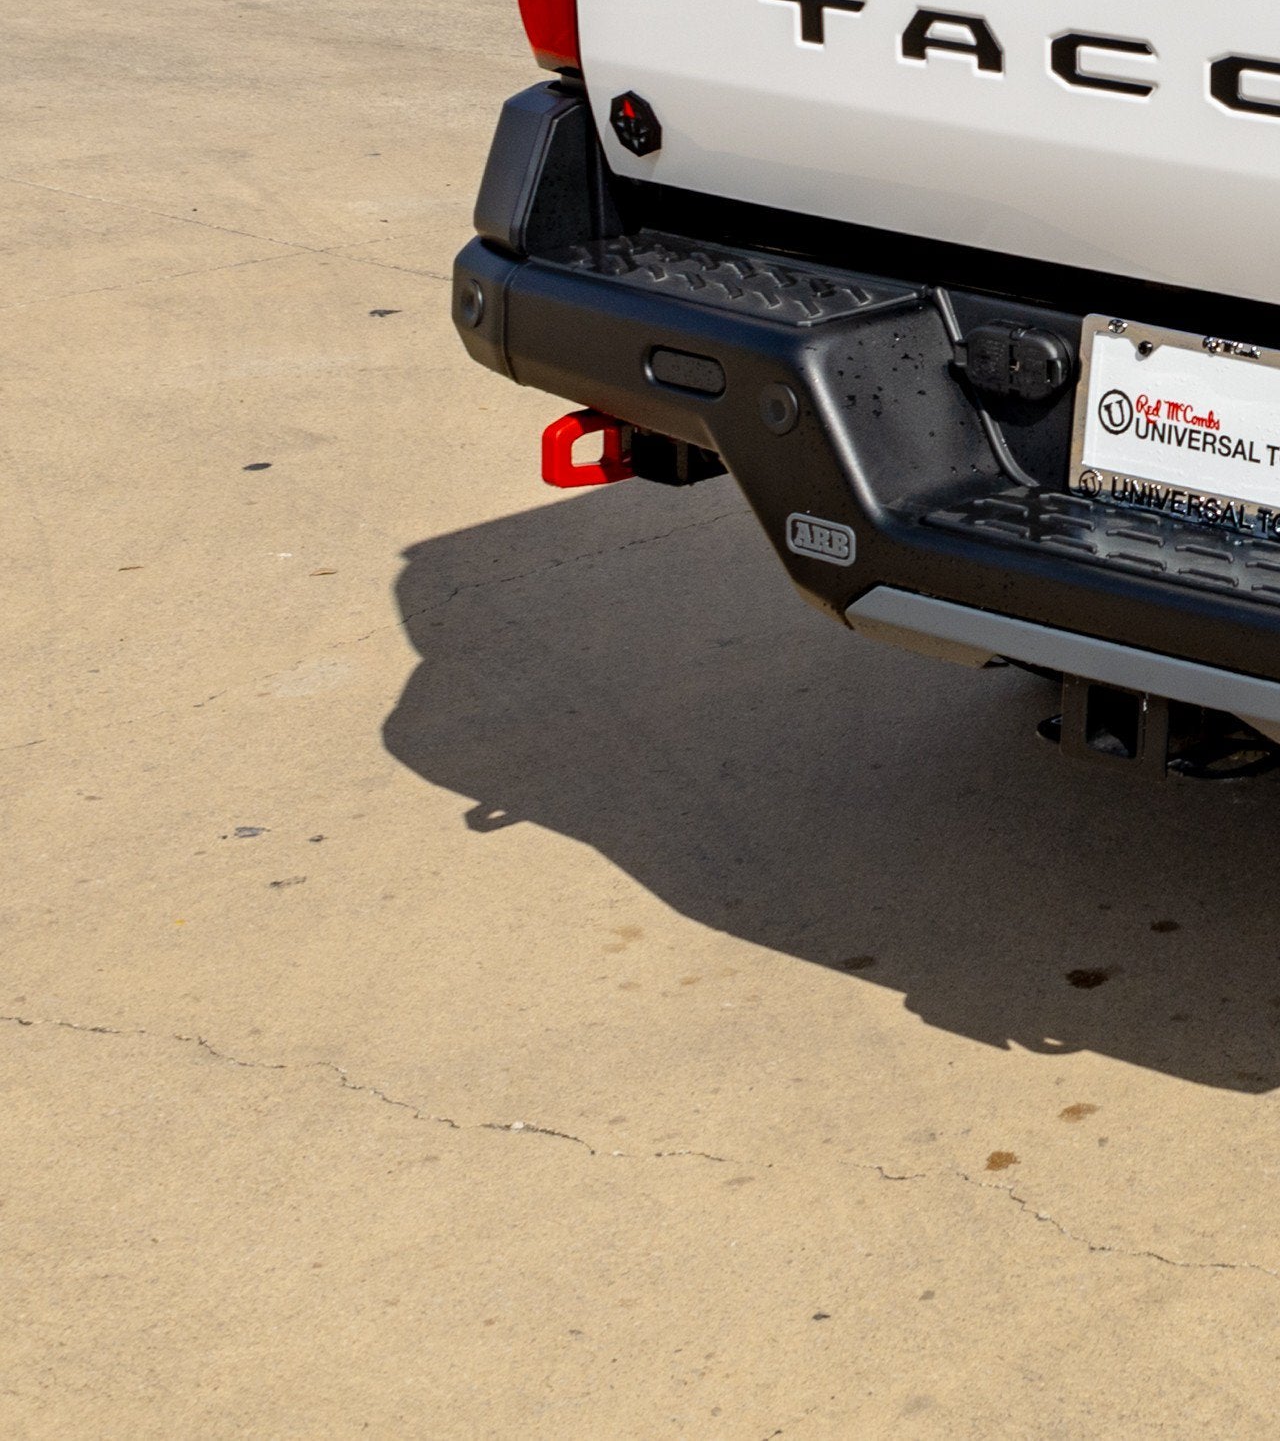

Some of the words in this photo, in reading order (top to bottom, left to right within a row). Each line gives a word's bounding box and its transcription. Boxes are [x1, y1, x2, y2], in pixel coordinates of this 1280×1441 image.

[1135, 394, 1161, 425] Red
[1135, 417, 1261, 464] UNIVERSAL
[1111, 476, 1254, 529] UNIVERSAL
[794, 521, 848, 559] ARB
